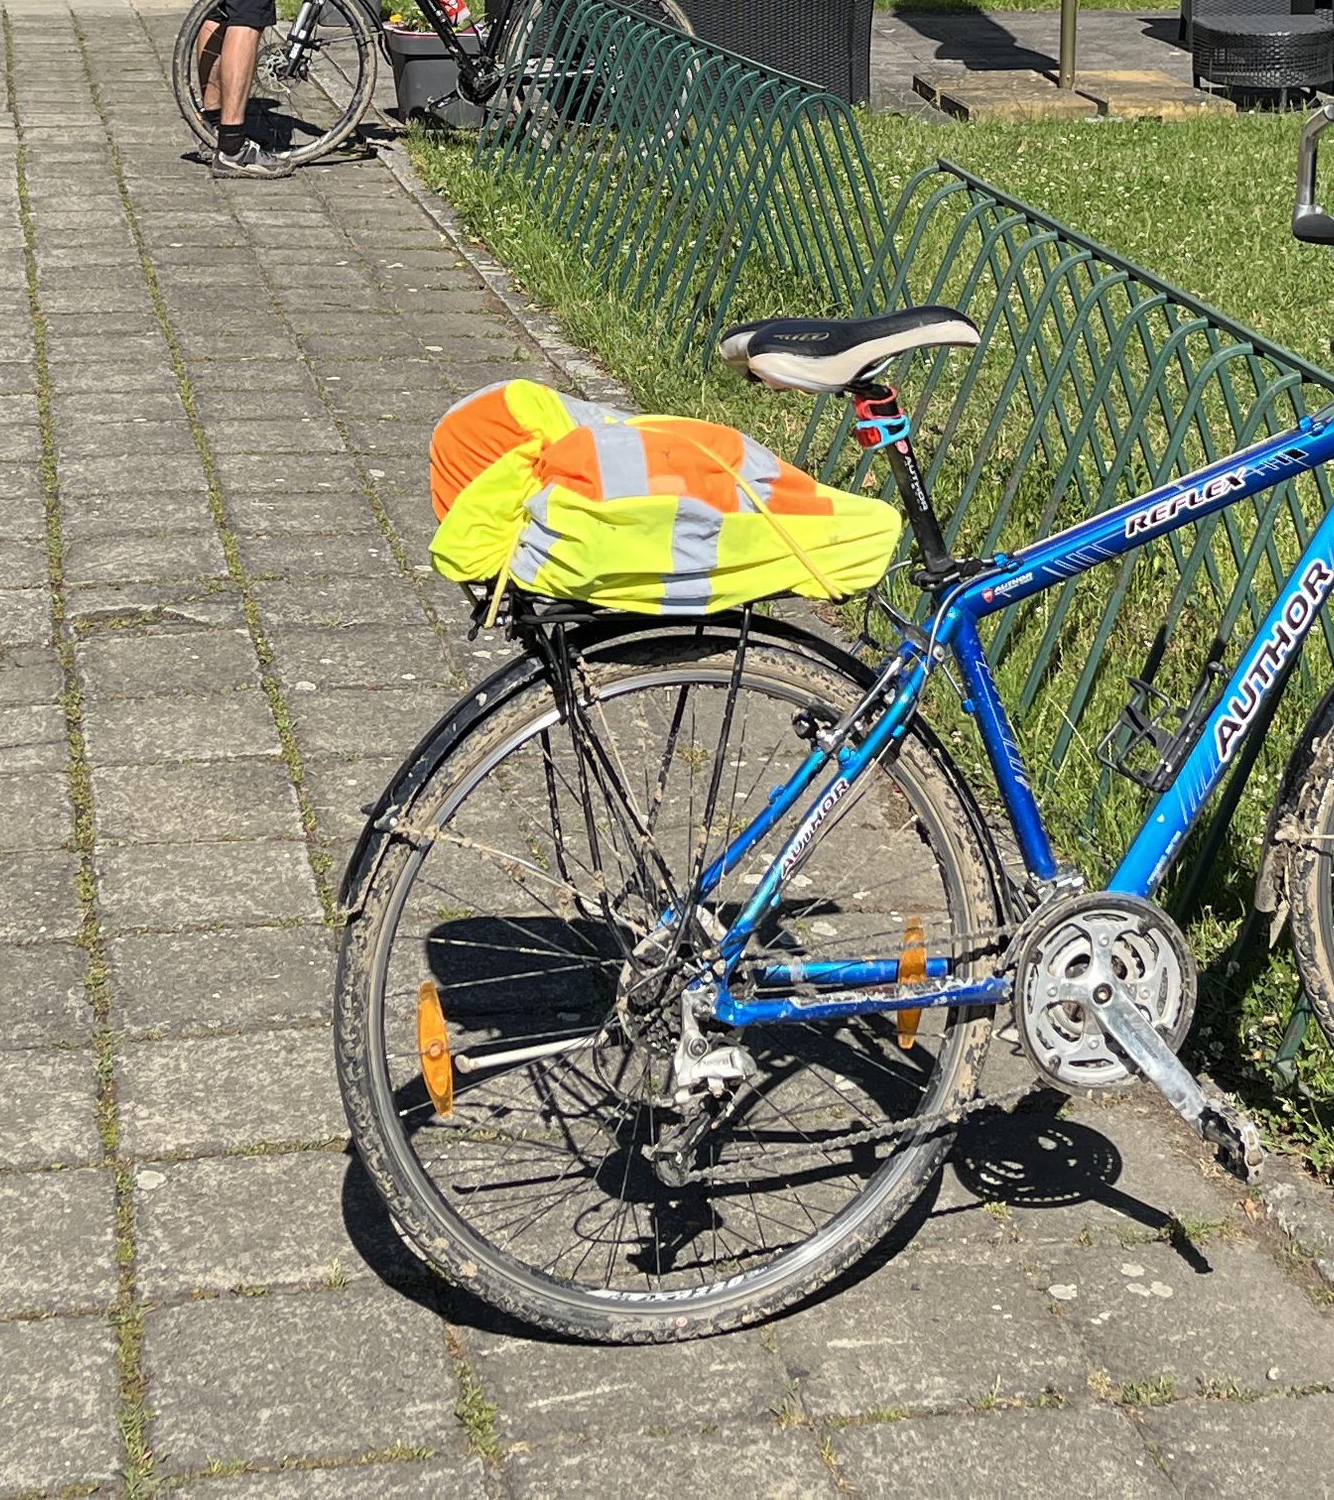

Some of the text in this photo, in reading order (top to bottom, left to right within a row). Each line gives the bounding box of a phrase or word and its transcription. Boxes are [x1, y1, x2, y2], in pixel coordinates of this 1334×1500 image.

[1124, 466, 1247, 539] REFLEX
[1214, 557, 1334, 763] AUTHOR
[780, 777, 851, 880] AUTHOR
